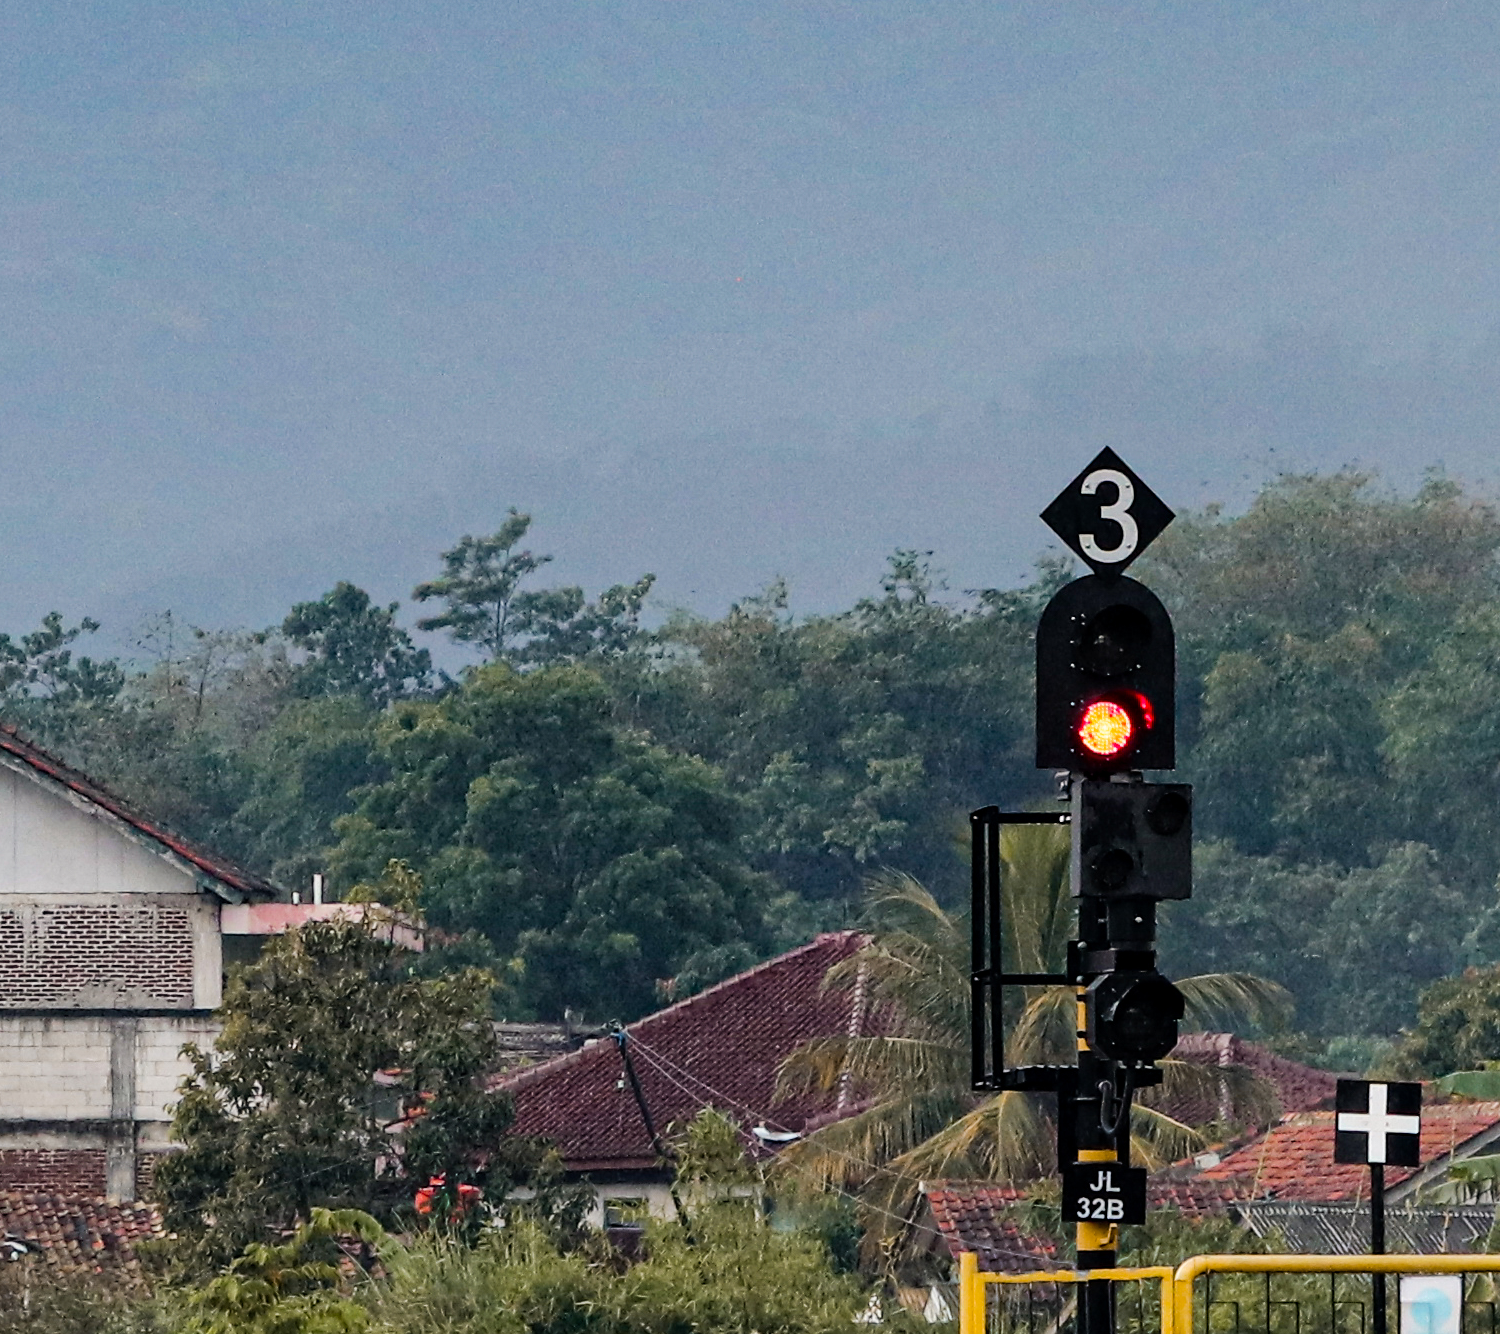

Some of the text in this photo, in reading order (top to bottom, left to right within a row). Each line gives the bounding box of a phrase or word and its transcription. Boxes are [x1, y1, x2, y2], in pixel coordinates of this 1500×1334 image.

[1079, 469, 1138, 563] 3
[1089, 1171, 1120, 1192] JL
[1077, 1197, 1124, 1219] 32B
